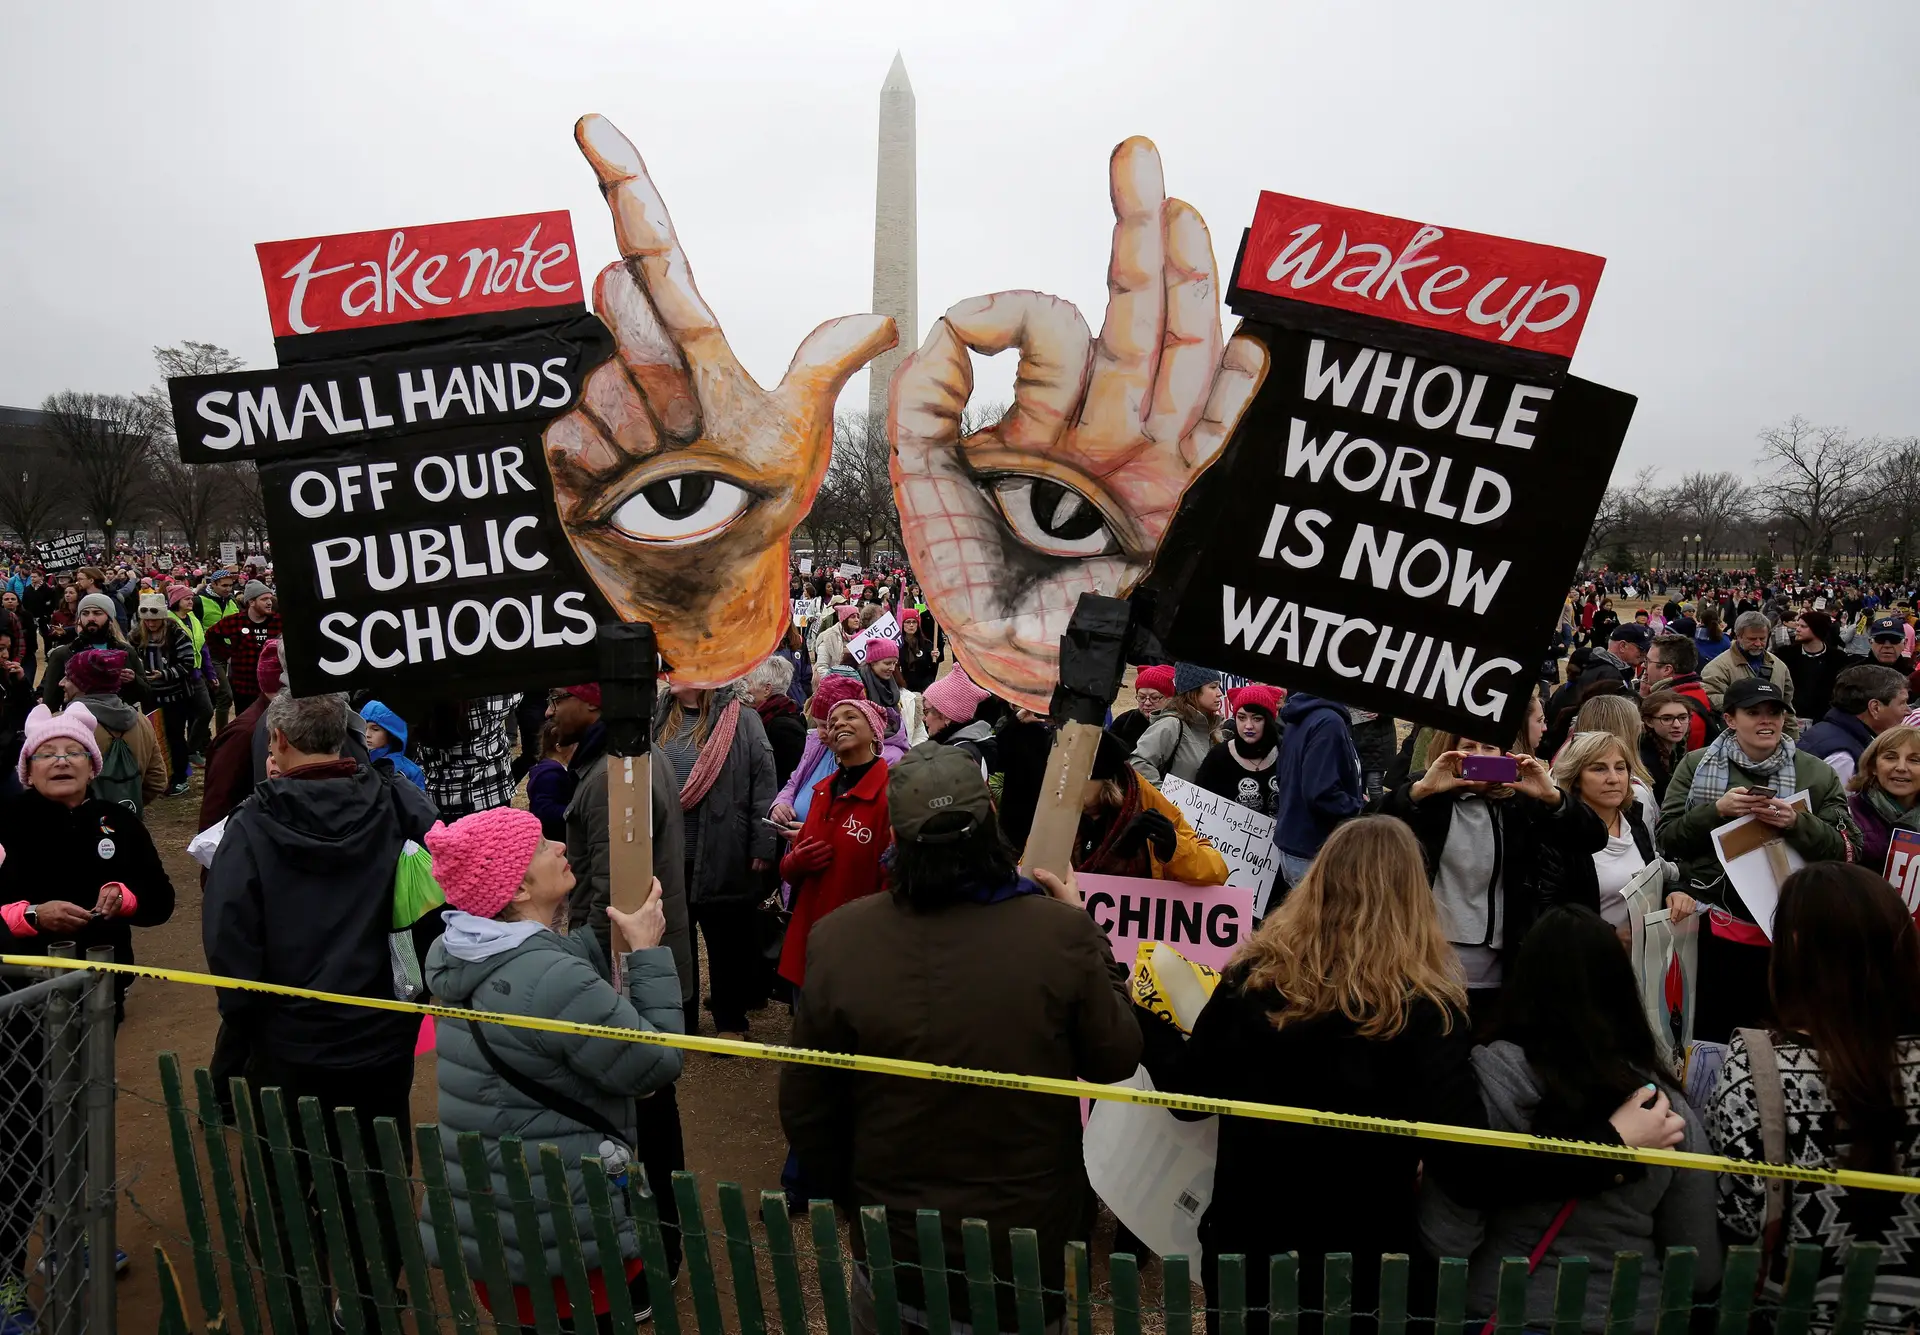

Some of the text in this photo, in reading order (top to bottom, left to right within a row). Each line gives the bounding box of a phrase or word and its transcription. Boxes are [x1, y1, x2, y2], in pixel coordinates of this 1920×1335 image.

[282, 223, 575, 334] take note
[1266, 223, 1580, 342] wake up
[196, 357, 572, 450] SMALL HANDS
[1303, 339, 1555, 450] WHOLE
[290, 446, 537, 519] OFF OUR
[1284, 416, 1512, 525] WORLD
[36, 543, 51, 551] WE
[43, 559, 65, 569] CANNOT
[65, 556, 78, 565] REST
[51, 545, 81, 559] FREEDOM
[311, 515, 550, 600] PUBLIC
[1258, 503, 1512, 615] IS NOW
[318, 591, 597, 676] SCHOOLS
[855, 644, 869, 661] D
[865, 625, 880, 638] WE
[1222, 584, 1523, 723] WATCHING
[1185, 787, 1273, 838] Stand Together!
[1220, 840, 1241, 857] are
[1079, 891, 1239, 948] CHING
